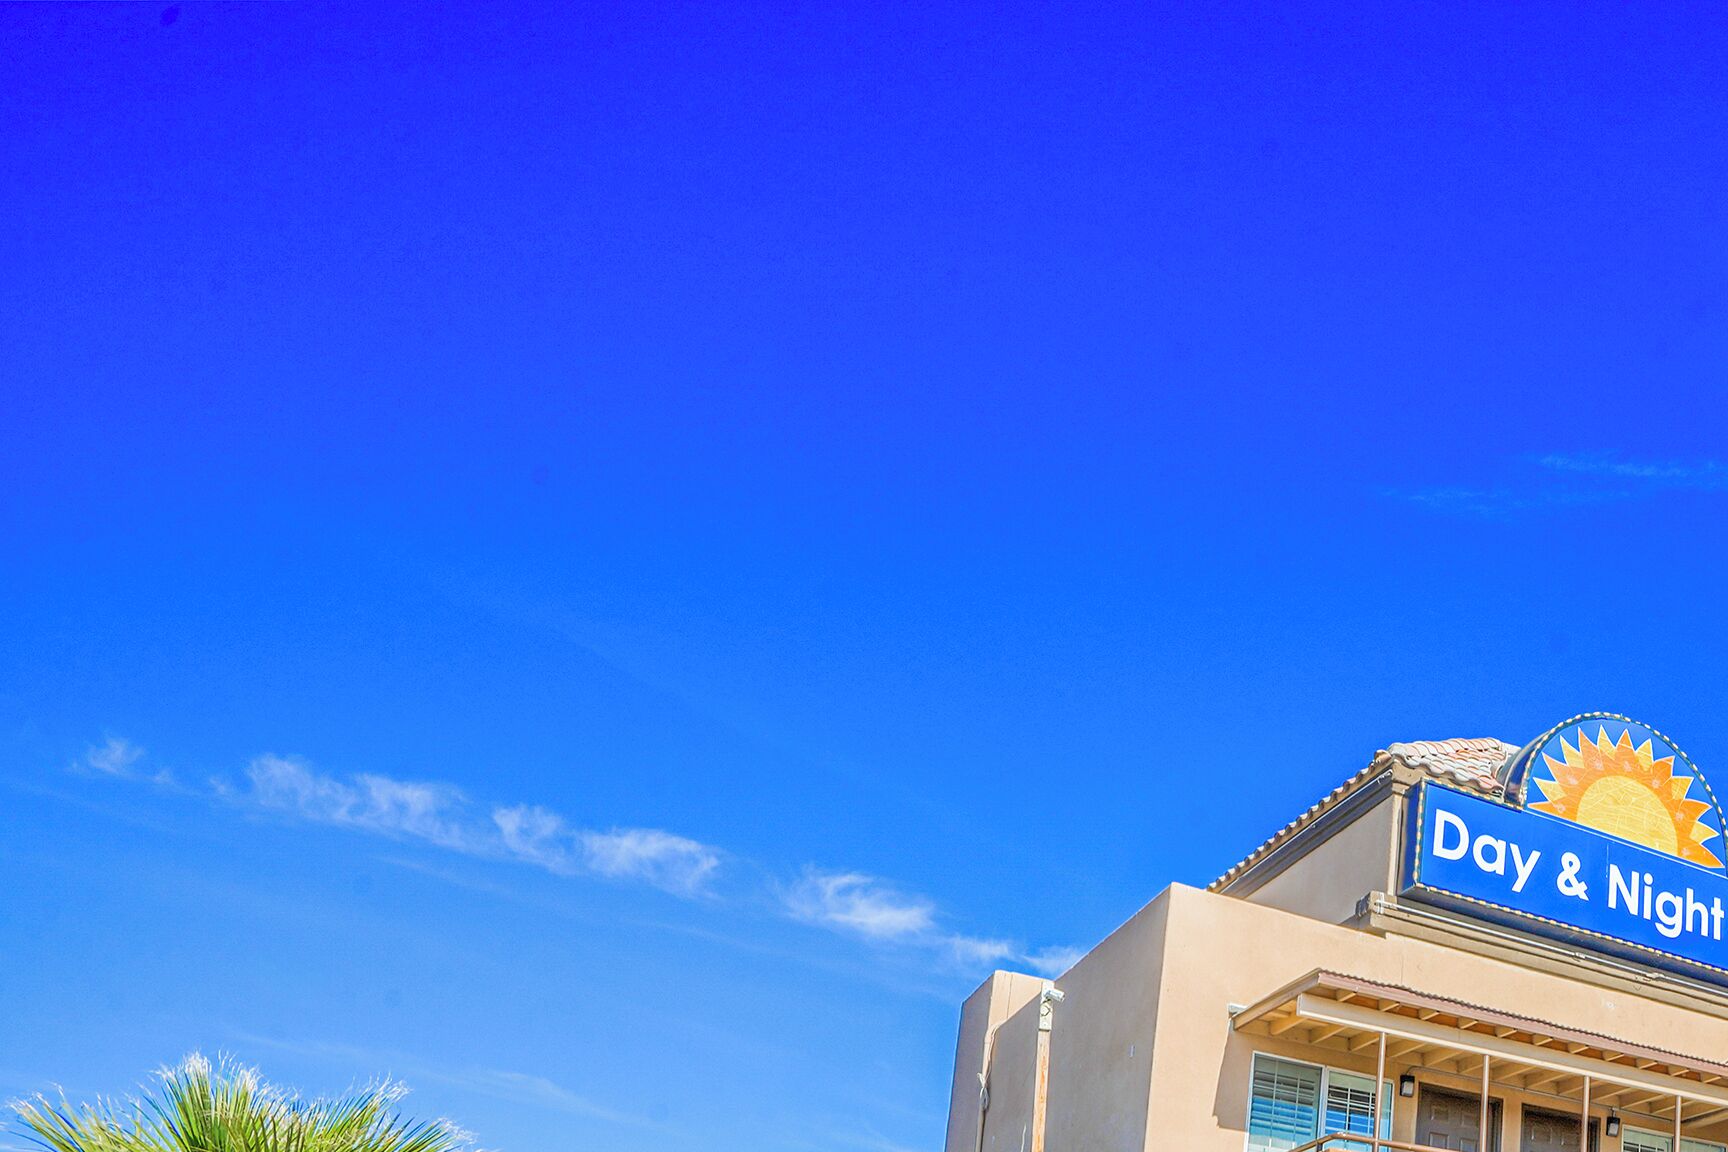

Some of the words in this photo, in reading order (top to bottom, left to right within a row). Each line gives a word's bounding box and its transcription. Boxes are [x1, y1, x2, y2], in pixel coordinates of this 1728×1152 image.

[1433, 808, 1541, 892] Day
[1556, 851, 1589, 901] &
[1608, 864, 1724, 939] Night
